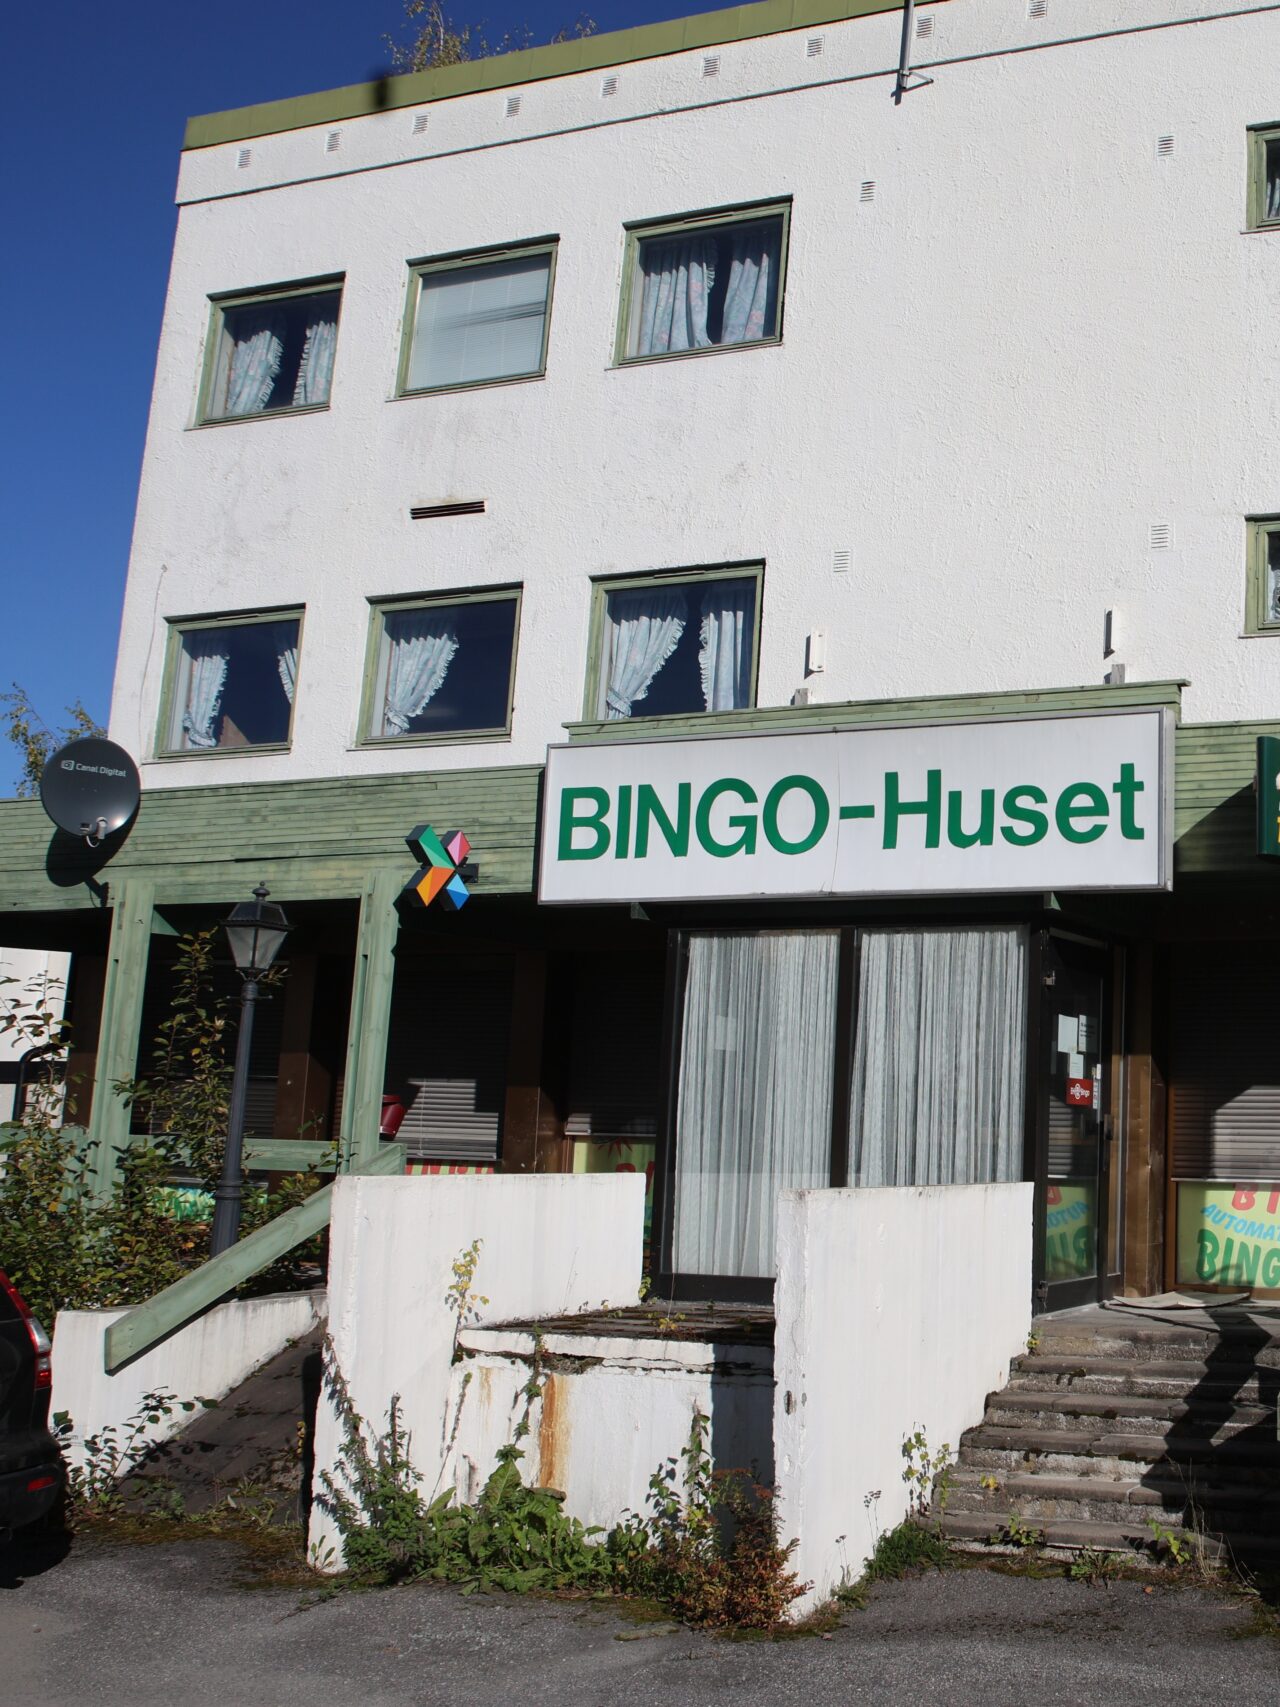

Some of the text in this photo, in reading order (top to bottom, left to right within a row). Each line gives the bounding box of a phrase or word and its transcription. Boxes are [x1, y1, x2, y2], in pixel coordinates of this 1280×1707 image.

[76, 763, 127, 776] Canal Digital
[556, 762, 1145, 861] BINGO-Huset
